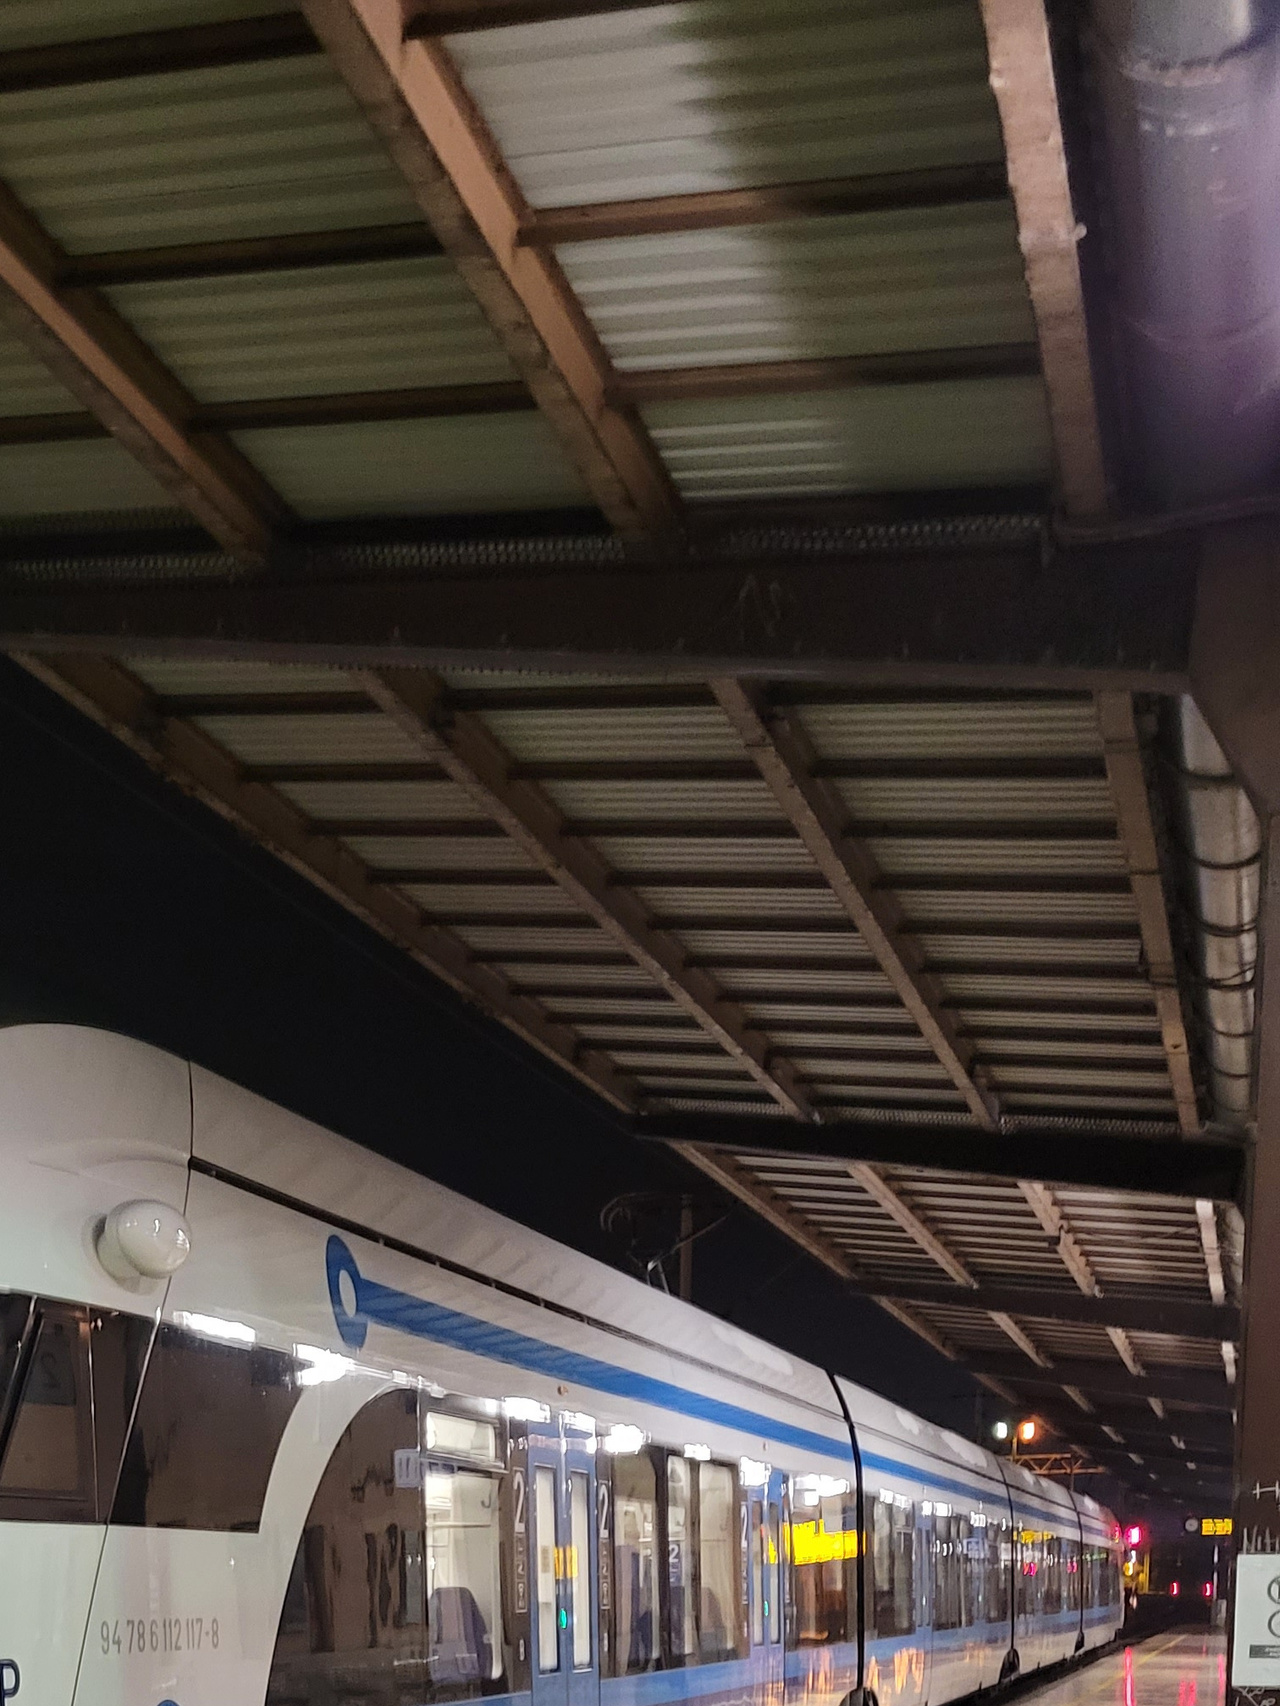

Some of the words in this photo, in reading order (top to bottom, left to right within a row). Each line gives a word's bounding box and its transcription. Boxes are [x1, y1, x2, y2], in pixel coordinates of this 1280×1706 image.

[513, 1471, 526, 1534] 2
[599, 1484, 609, 1538] 2
[668, 1544, 679, 1563] 2
[101, 1620, 121, 1654] 94
[126, 1619, 146, 1654] 78
[150, 1619, 159, 1652] 6
[163, 1618, 182, 1652] 112
[186, 1617, 219, 1649] 117-8
